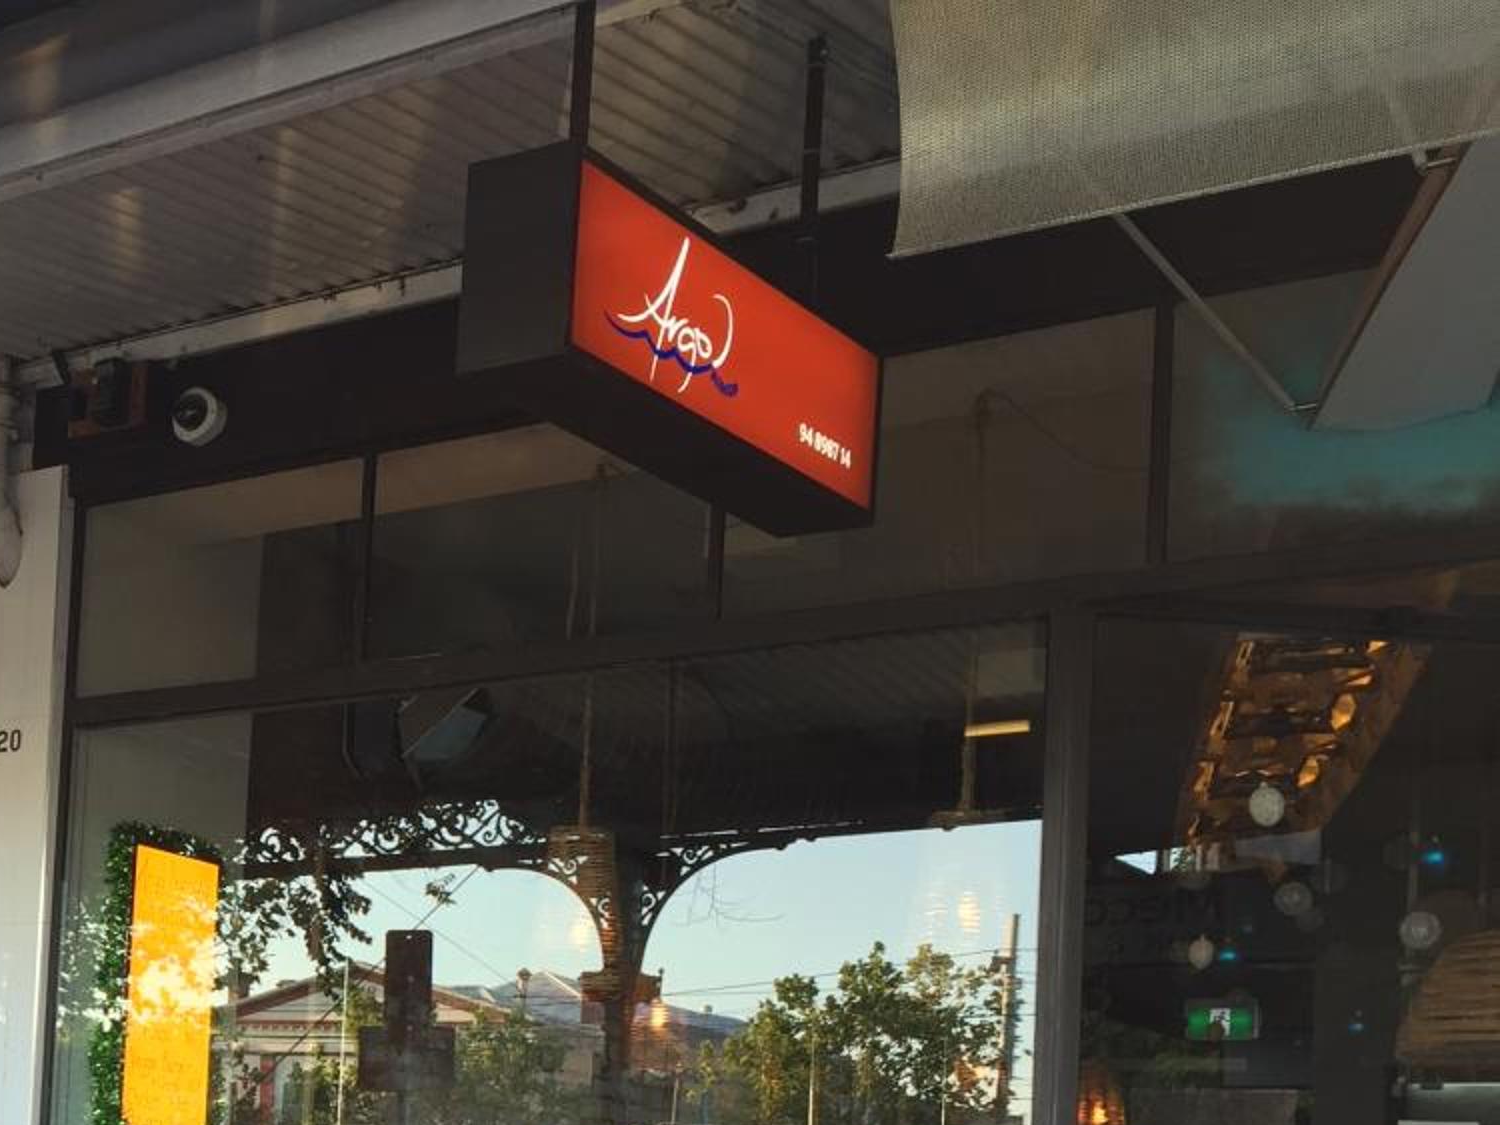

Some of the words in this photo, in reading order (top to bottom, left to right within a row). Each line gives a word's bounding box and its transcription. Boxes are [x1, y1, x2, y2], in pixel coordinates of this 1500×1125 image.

[617, 236, 733, 393] Argo
[799, 422, 813, 448] 94
[814, 431, 840, 461] 8987
